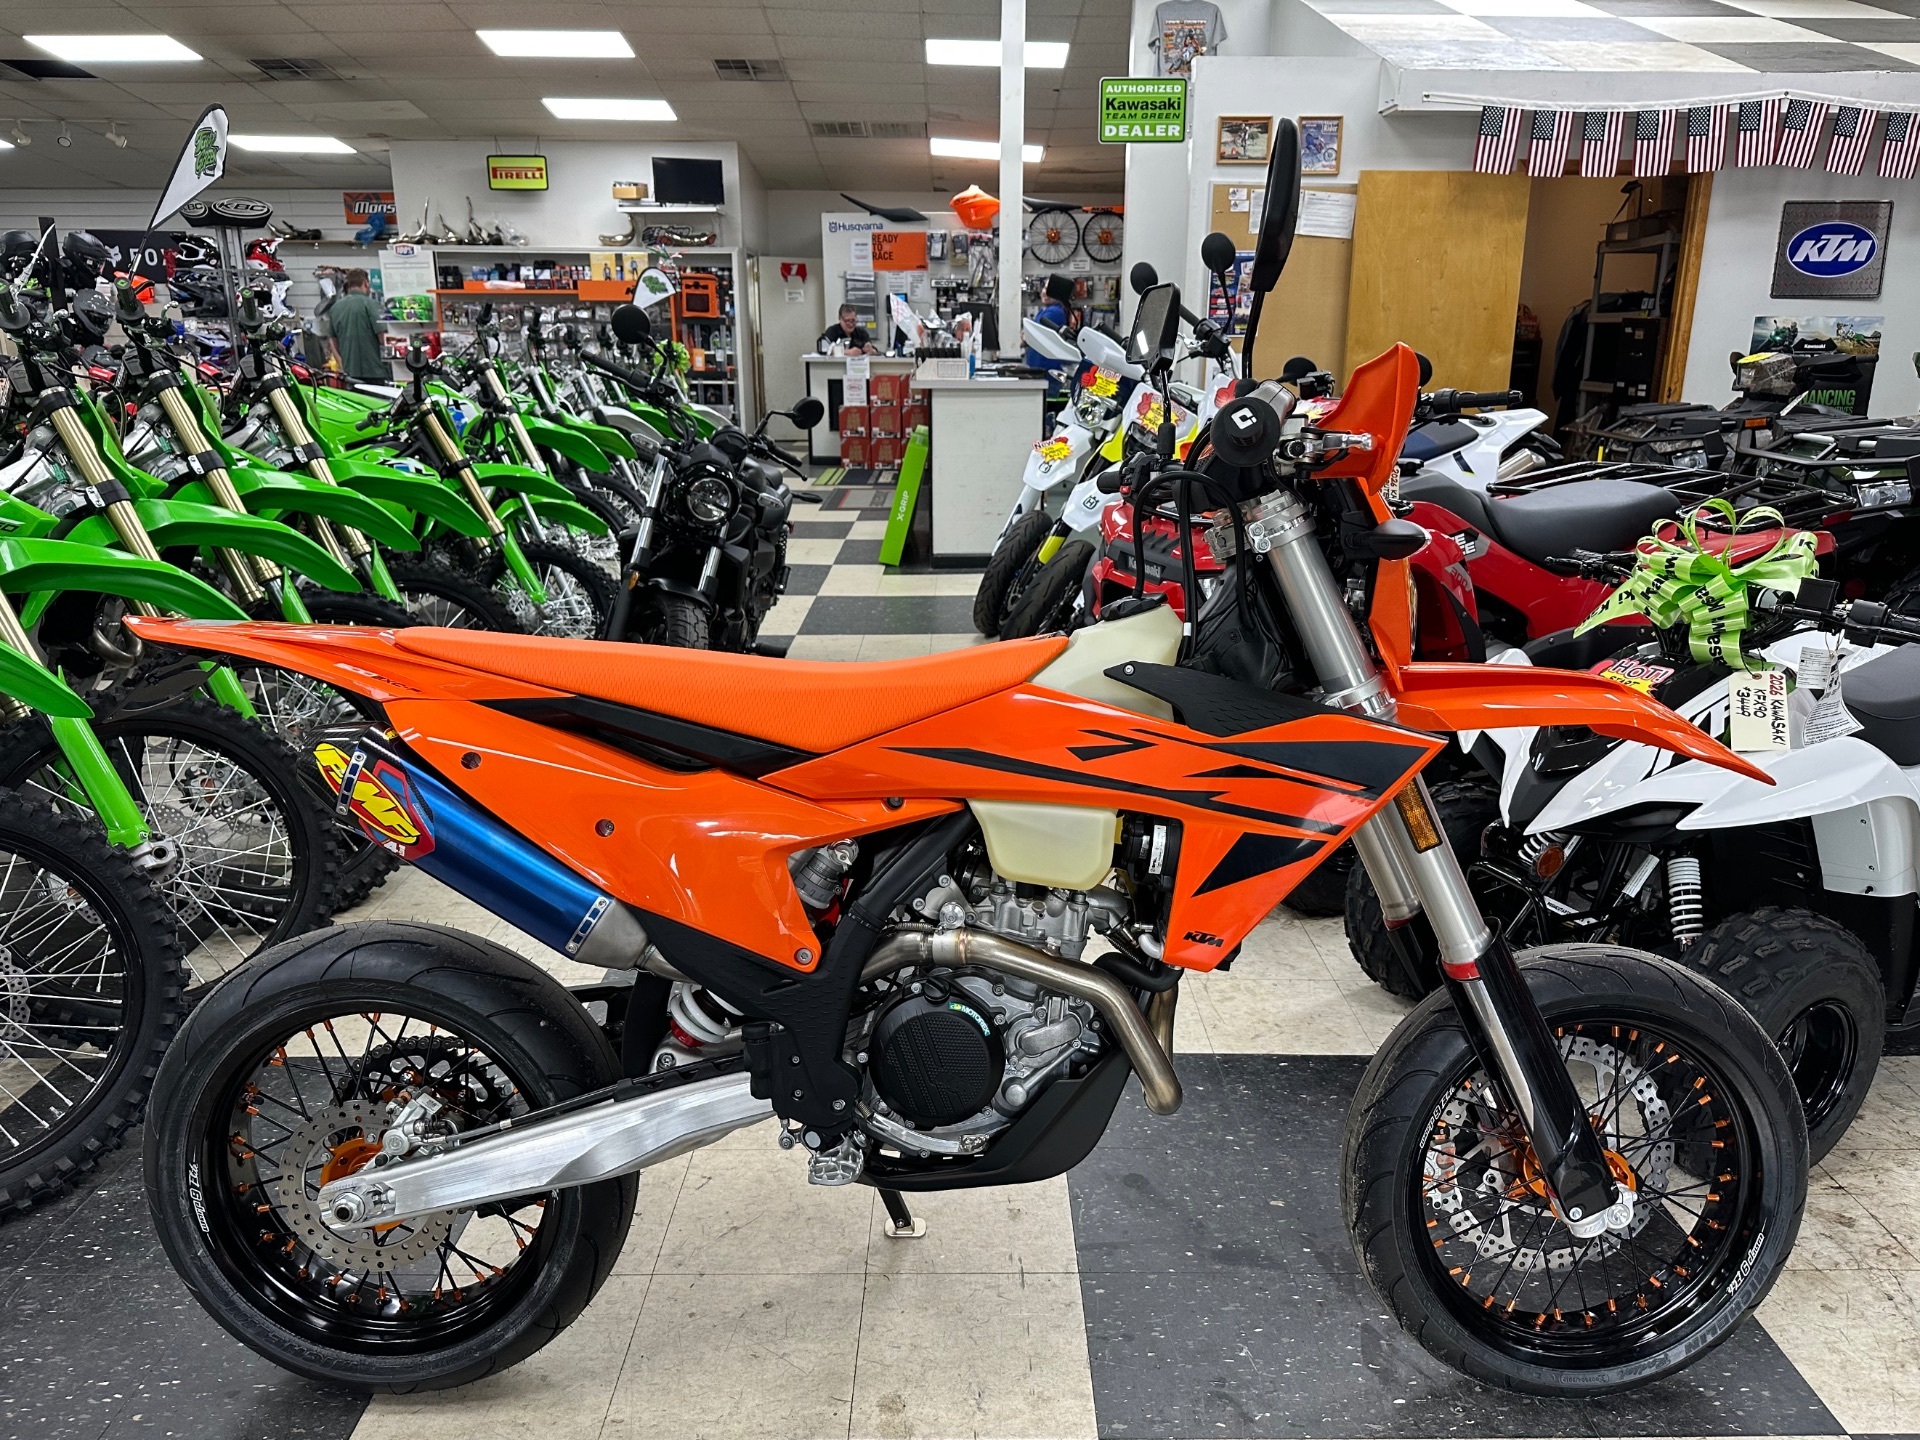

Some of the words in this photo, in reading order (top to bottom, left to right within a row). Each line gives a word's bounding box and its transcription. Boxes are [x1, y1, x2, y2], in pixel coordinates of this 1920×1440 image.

[1105, 85, 1182, 93] AUTHORIZED
[1105, 97, 1182, 111] Kawasaki
[1105, 112, 1137, 120] TEAM
[1140, 112, 1181, 120] GREEN
[1104, 124, 1181, 137] DEALER
[491, 166, 544, 180] PIRELLI
[217, 202, 267, 212] KBC
[838, 222, 883, 231] Husqvarna
[871, 234, 899, 244] READY
[872, 243, 883, 252] TO
[1791, 234, 1873, 262] KTM
[872, 252, 894, 261] RACE
[1391, 469, 1400, 487] 2026
[1611, 660, 1669, 682] HOT!
[1769, 673, 1784, 696] 2026
[1752, 688, 1768, 719] KFX90
[1769, 698, 1787, 746] KAWASAKI
[1183, 931, 1225, 948] KTM
[961, 1004, 991, 1037] MOTOREX
[1684, 1261, 1770, 1356] MICHELIN
